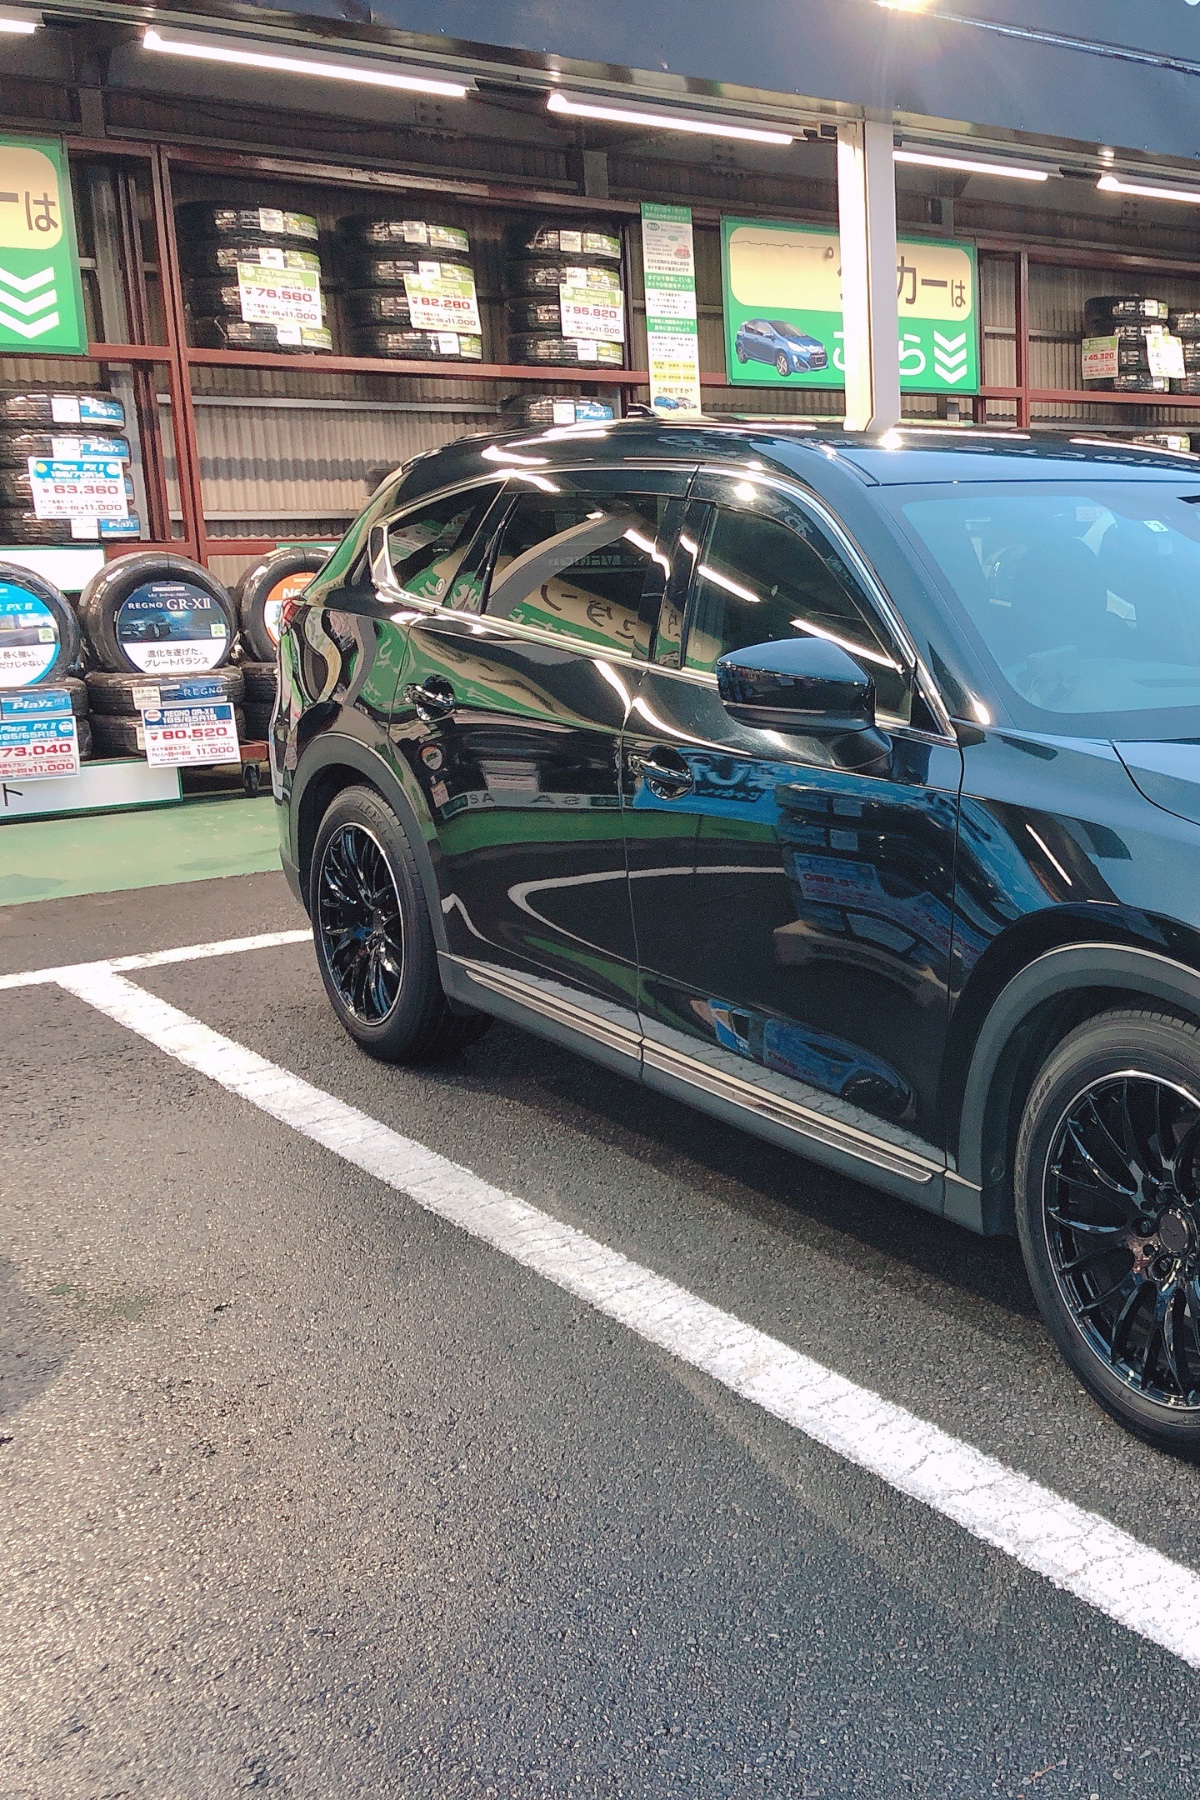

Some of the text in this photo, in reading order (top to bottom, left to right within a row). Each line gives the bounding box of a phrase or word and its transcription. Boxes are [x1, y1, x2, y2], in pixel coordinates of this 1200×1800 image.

[128, 602, 163, 610] REGNO
[144, 657, 210, 668] グレートバランス
[183, 686, 223, 697] REGNO
[13, 700, 54, 710] Playz
